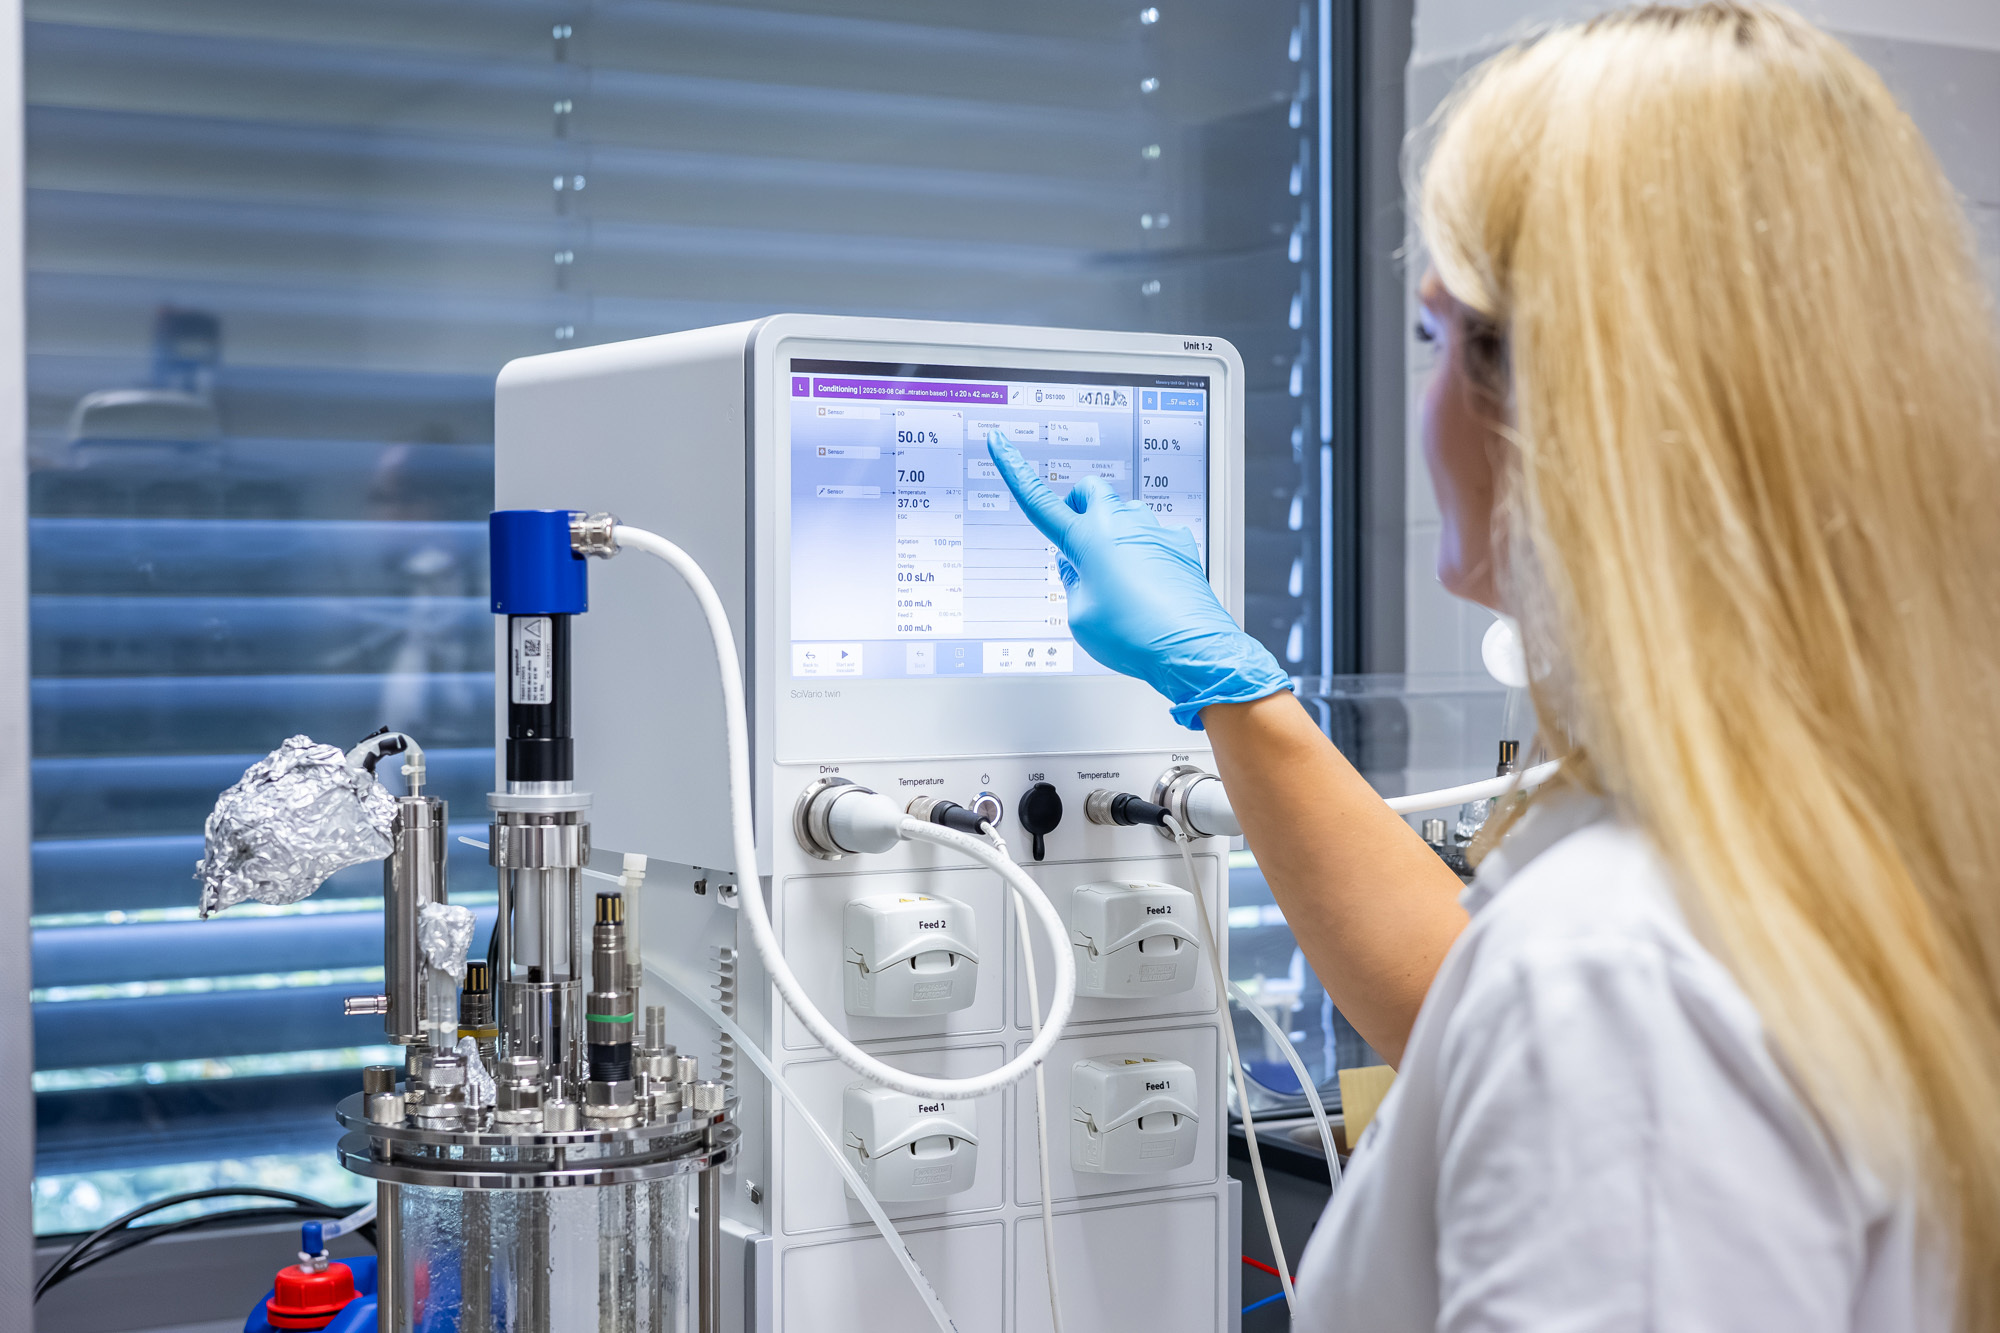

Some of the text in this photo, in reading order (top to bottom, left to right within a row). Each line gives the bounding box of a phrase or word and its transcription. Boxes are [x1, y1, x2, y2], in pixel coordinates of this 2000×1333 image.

[1183, 341, 1213, 351] Unit 1-2
[818, 384, 858, 394] Conditioning
[898, 430, 938, 444] 50.0 %
[1144, 438, 1181, 451] 50.0 %
[898, 470, 925, 482] 7.00
[1143, 476, 1168, 488] 7.00
[897, 498, 930, 508] 37.0°C
[1145, 503, 1173, 512] 7.0°C
[898, 572, 935, 582] 0.0 sL/h
[914, 600, 932, 608] mL/h
[897, 624, 932, 632] 0.00 mL/h
[790, 690, 841, 698] SciVario twin
[1172, 754, 1189, 762] Drive
[819, 765, 840, 774] Drive
[1028, 773, 1045, 781] USB
[1077, 770, 1120, 780] Temperature
[898, 777, 944, 787] Temperature
[1146, 906, 1172, 915] Feed 2
[919, 920, 947, 929] Feed 2
[1146, 1081, 1170, 1091] Feed 1
[918, 1103, 945, 1113] Feed 1
